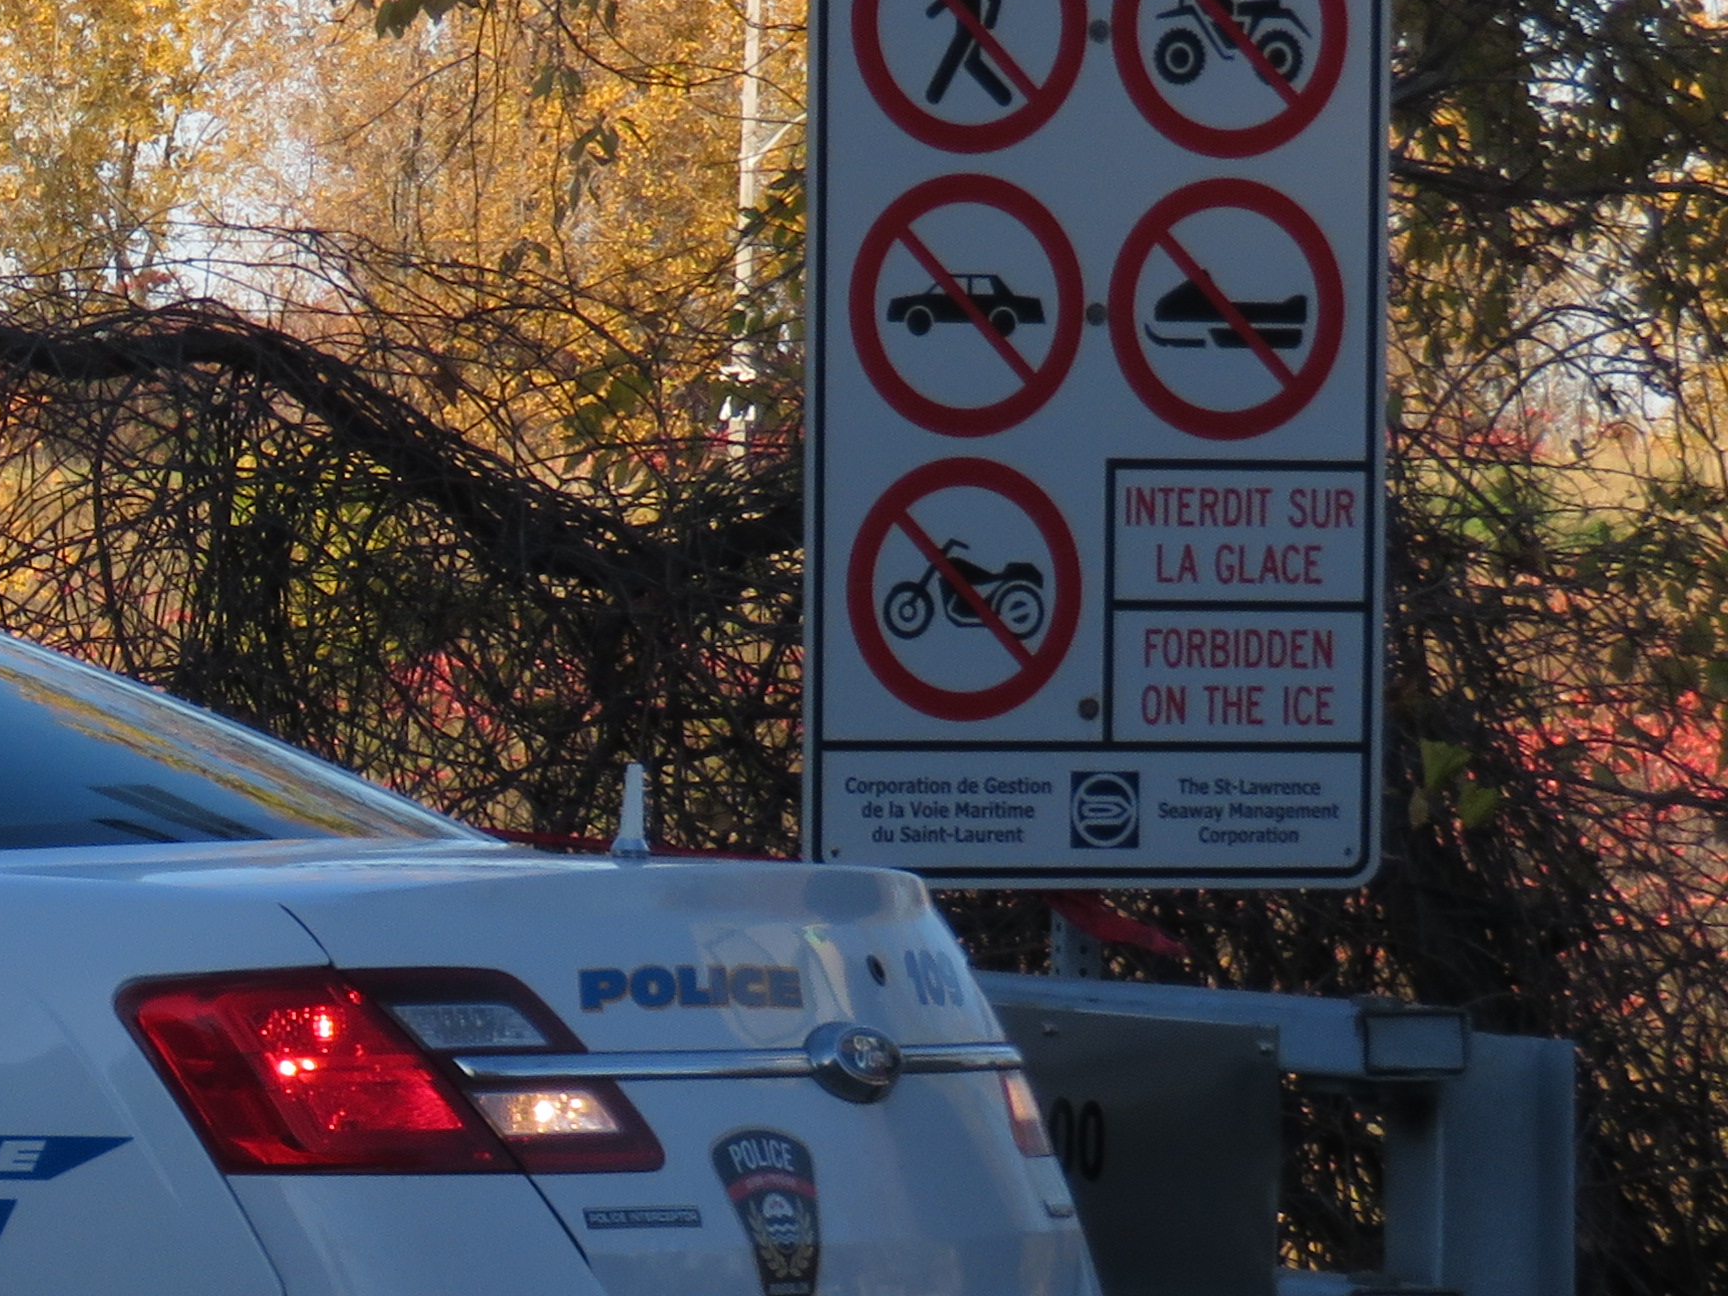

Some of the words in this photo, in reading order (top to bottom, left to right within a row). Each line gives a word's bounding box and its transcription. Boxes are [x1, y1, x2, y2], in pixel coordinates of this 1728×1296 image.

[1124, 486, 1274, 529] INTERDIT
[1288, 489, 1356, 530] SUR
[1155, 544, 1199, 584] LA
[1214, 544, 1324, 585] GLACE
[1143, 629, 1334, 670] FORBIDDEN
[1140, 686, 1187, 725] ON
[1204, 686, 1264, 726] THE
[1282, 686, 1334, 726] ICE
[844, 777, 952, 798] Corporation
[957, 777, 979, 795] de
[983, 777, 1053, 795] Gestion
[1178, 777, 1210, 795] The
[861, 801, 884, 819] de
[888, 801, 905, 819] la
[909, 801, 950, 819] Voie
[954, 802, 1036, 819] Maritime
[1157, 802, 1224, 822] Seaway
[1228, 802, 1340, 823] Management
[872, 826, 894, 843] du
[899, 826, 1024, 843] Saint-Laurent
[1197, 826, 1300, 845] Corporation
[579, 965, 806, 1011] POLICE
[727, 1138, 796, 1174] POLICE
